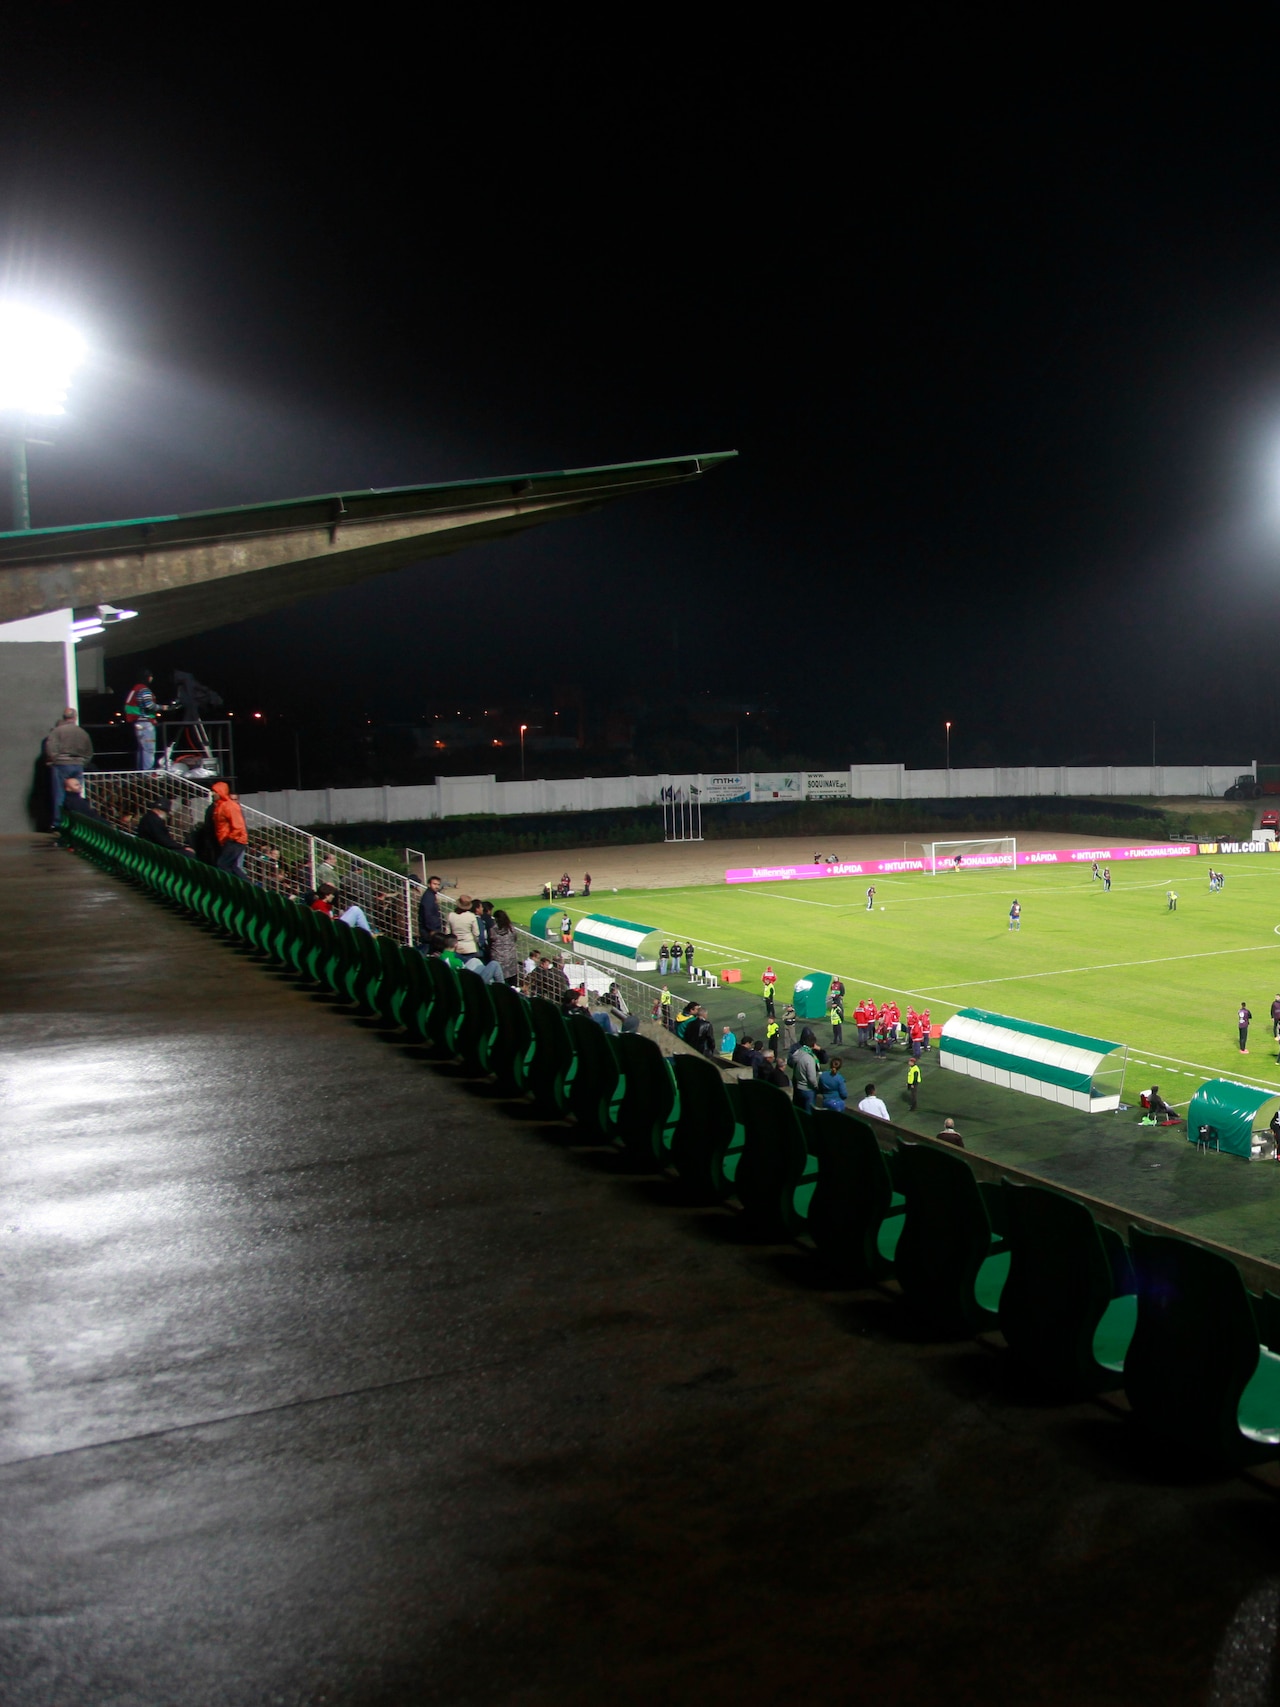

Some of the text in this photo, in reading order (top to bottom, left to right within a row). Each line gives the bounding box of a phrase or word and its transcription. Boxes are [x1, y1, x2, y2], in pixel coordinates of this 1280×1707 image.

[1031, 852, 1057, 863] RÁPIDA
[1077, 850, 1111, 860] INTUITIVA
[1129, 846, 1191, 857] FUNCIONALIDADES
[1221, 841, 1266, 853] wu.com
[752, 868, 796, 877] Millennium
[833, 863, 862, 874] RÁPIDA
[884, 860, 923, 871] INTUITIVA
